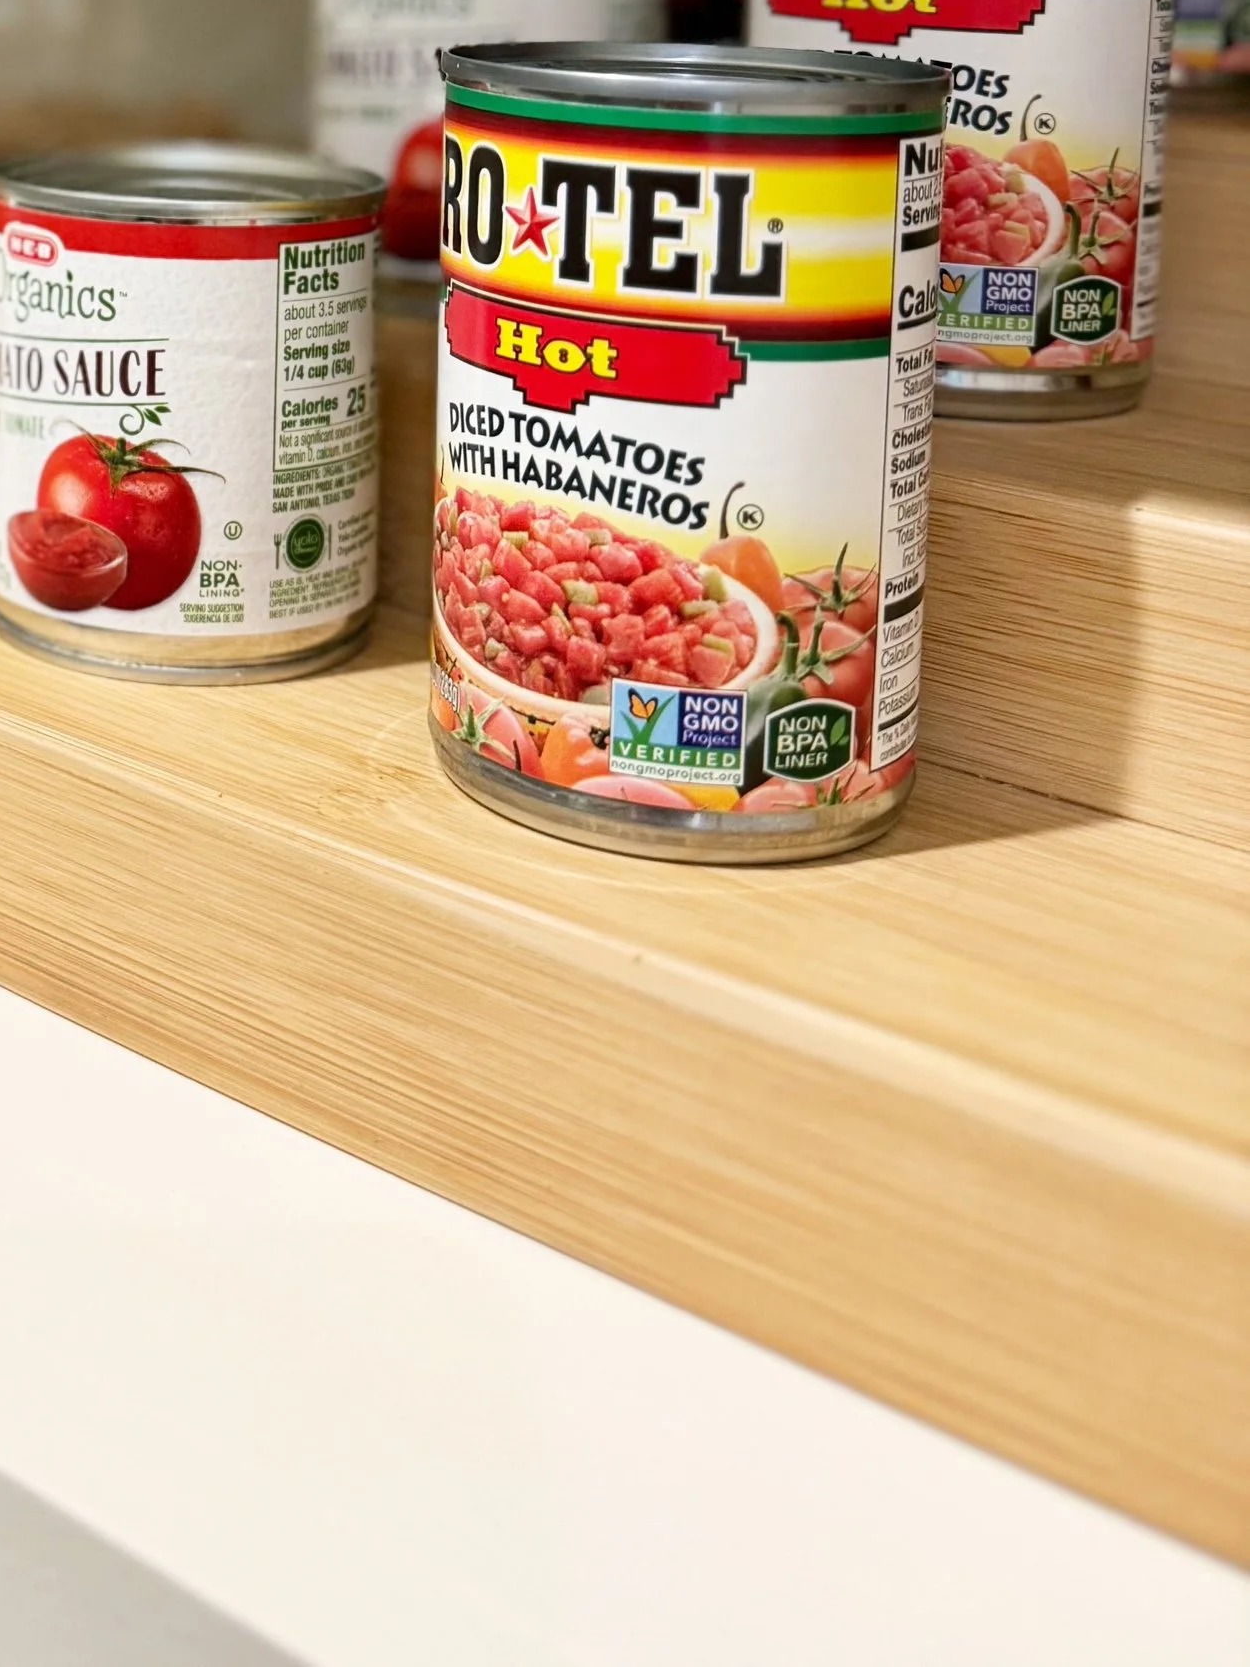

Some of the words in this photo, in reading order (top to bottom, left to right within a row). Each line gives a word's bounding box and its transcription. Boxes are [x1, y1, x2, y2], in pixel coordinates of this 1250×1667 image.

[284, 241, 365, 270] Nutrition
[283, 268, 340, 295] Facts
[988, 271, 1032, 288] NON
[986, 286, 1033, 302] GMO
[1063, 289, 1101, 303] NON
[284, 302, 316, 321] about
[318, 300, 334, 318] 3.5
[336, 295, 367, 315] servings
[985, 299, 1031, 314] Project
[1061, 303, 1102, 320] BPA
[284, 327, 303, 344] per
[306, 320, 349, 339] container
[1059, 319, 1101, 333] LINER
[283, 343, 328, 361] Serving
[331, 339, 350, 355] size
[495, 318, 619, 380] Hot
[53, 349, 166, 397] SAUCE
[283, 365, 304, 381] 1/4
[307, 364, 328, 380] cup
[331, 355, 355, 378] (63g)
[896, 354, 921, 375] Total
[281, 396, 339, 418] Calories
[346, 384, 366, 417] 25
[281, 419, 297, 431] per
[299, 414, 330, 426] serving
[279, 434, 292, 448] Not
[449, 401, 505, 438] DICED
[508, 410, 706, 486] TOMATOES
[891, 449, 926, 474] Sodium
[272, 487, 294, 500] MADE
[296, 483, 314, 497] WITH
[448, 441, 496, 477] WITH
[502, 449, 710, 530] HABANEROS
[890, 481, 916, 499] Total
[272, 501, 288, 514] SAN
[200, 573, 240, 588] BPA
[885, 571, 919, 599] Protein
[179, 603, 206, 613] SERVING
[880, 641, 914, 669] Calcium
[879, 674, 898, 695] Iron
[685, 695, 738, 714] NON
[878, 685, 915, 719] Potassium
[683, 713, 739, 733] GMO
[779, 714, 827, 733] NON
[682, 730, 737, 749] Project
[777, 732, 828, 754] BPA
[619, 741, 736, 767] VERIFIED
[774, 751, 828, 769] LINER
[611, 759, 741, 784] nongmoproject.org
